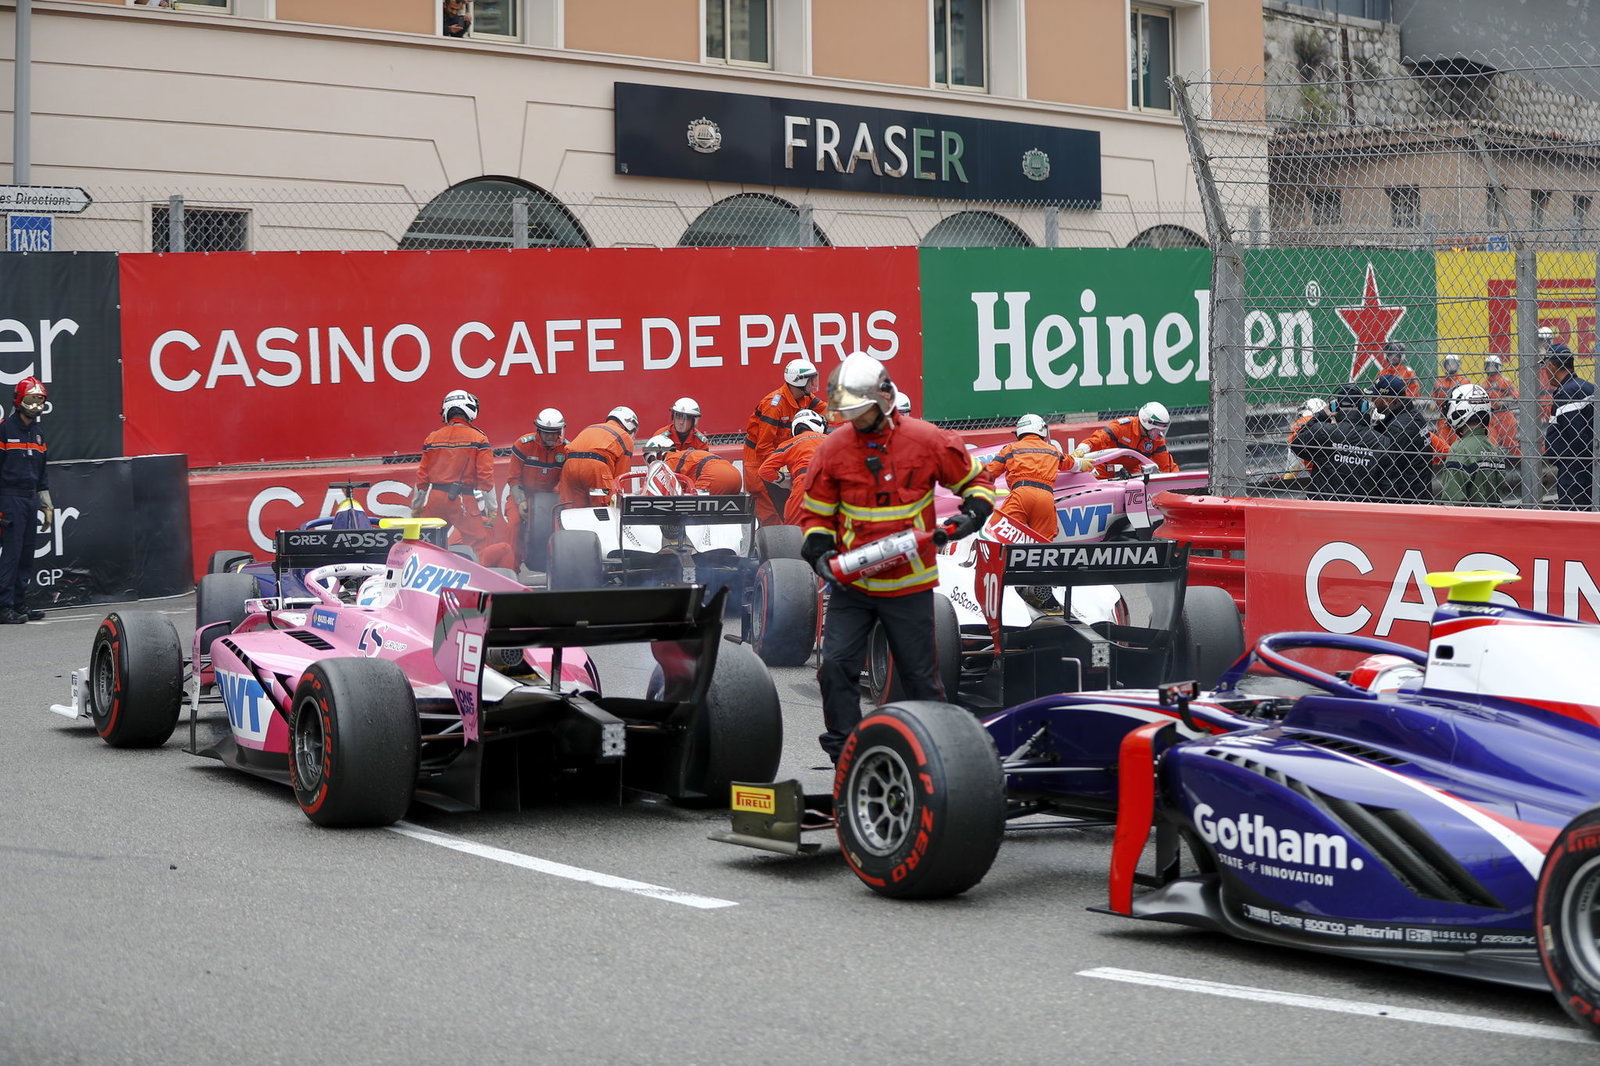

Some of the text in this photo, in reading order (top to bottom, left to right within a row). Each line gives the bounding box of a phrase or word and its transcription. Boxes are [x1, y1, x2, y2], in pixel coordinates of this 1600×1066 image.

[784, 115, 969, 183] FRASER
[15, 192, 72, 207] Directions
[13, 228, 50, 251] TAXIS
[150, 310, 900, 392] CASINO CAFE DE PARIS
[1334, 454, 1371, 467] CIRCUIT
[630, 500, 740, 513] PREMA
[289, 534, 327, 546] OREX
[1009, 546, 1159, 568] PERTAMINA
[36, 568, 64, 587] GP
[984, 572, 998, 620] 10
[456, 630, 483, 686] 19
[736, 791, 771, 809] PIRELLI
[1194, 803, 1364, 871] Gotham.
[1218, 853, 1243, 869] STATE
[1260, 864, 1334, 887] INNOVATION
[1304, 918, 1346, 935] sparco
[1348, 924, 1403, 941] allegrini
